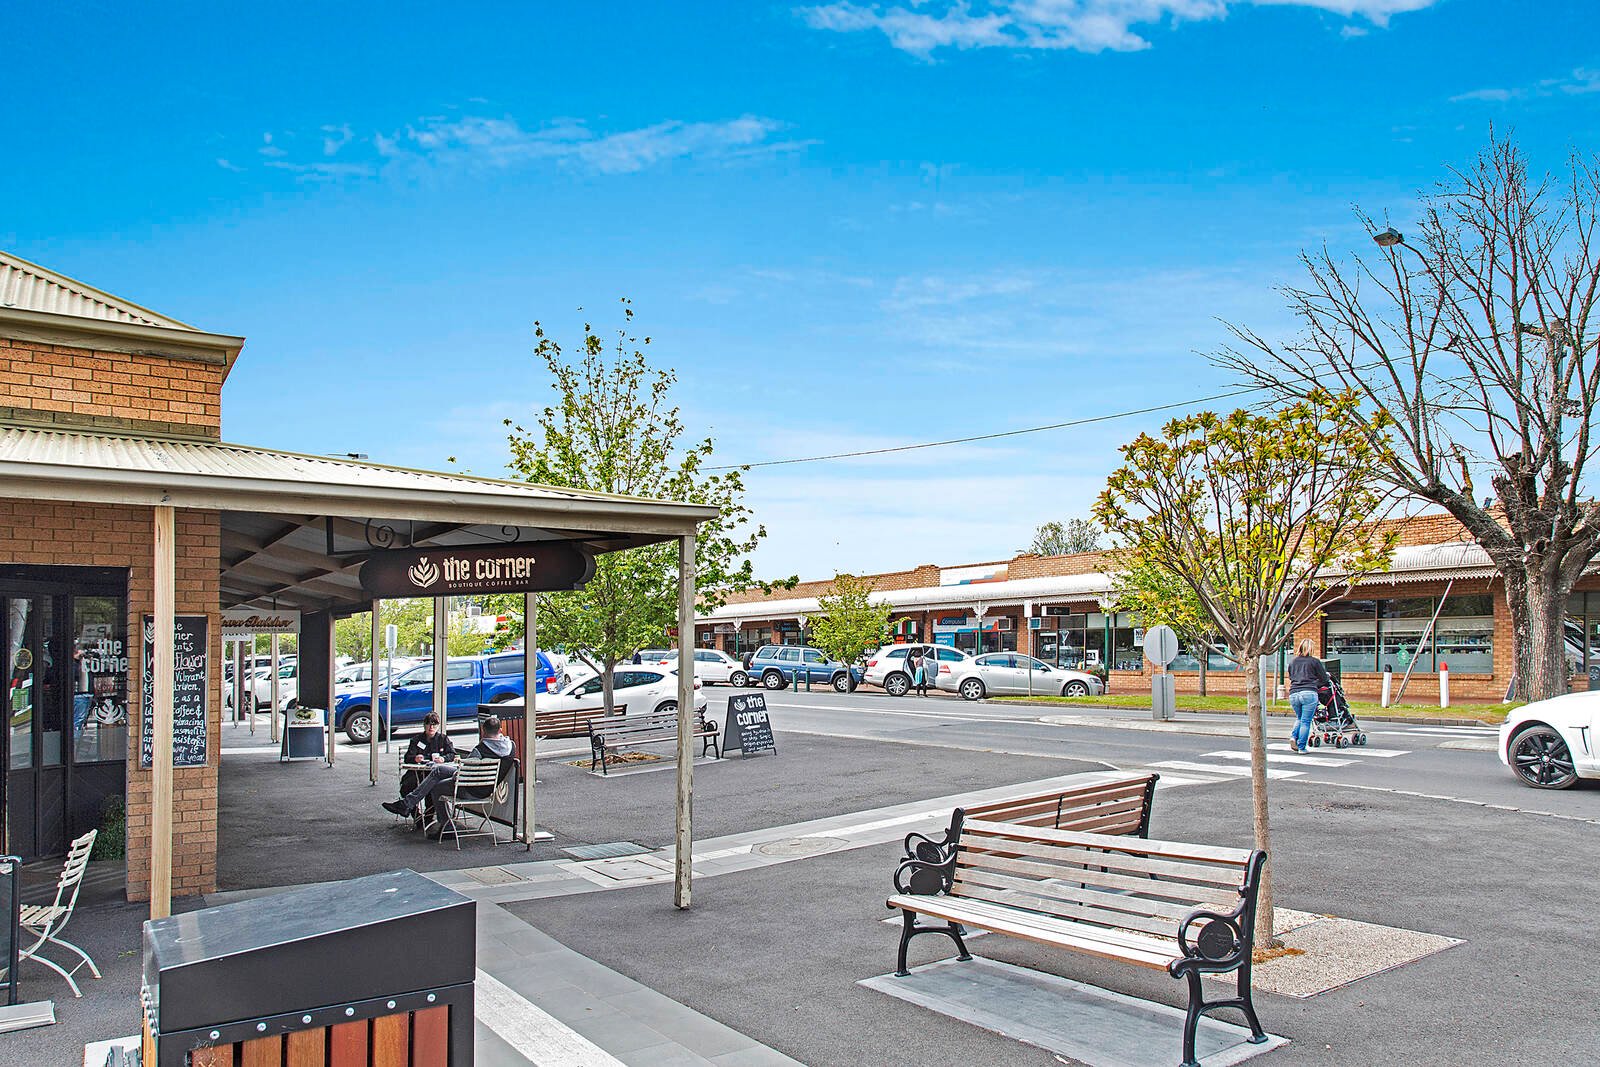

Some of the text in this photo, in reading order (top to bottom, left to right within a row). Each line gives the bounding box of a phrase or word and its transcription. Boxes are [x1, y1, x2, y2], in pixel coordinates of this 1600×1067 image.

[443, 556, 536, 581] the corner
[97, 639, 122, 655] the
[81, 657, 128, 673] corne
[746, 695, 764, 709] the
[173, 718, 204, 729] mbracing
[736, 710, 768, 725] corner
